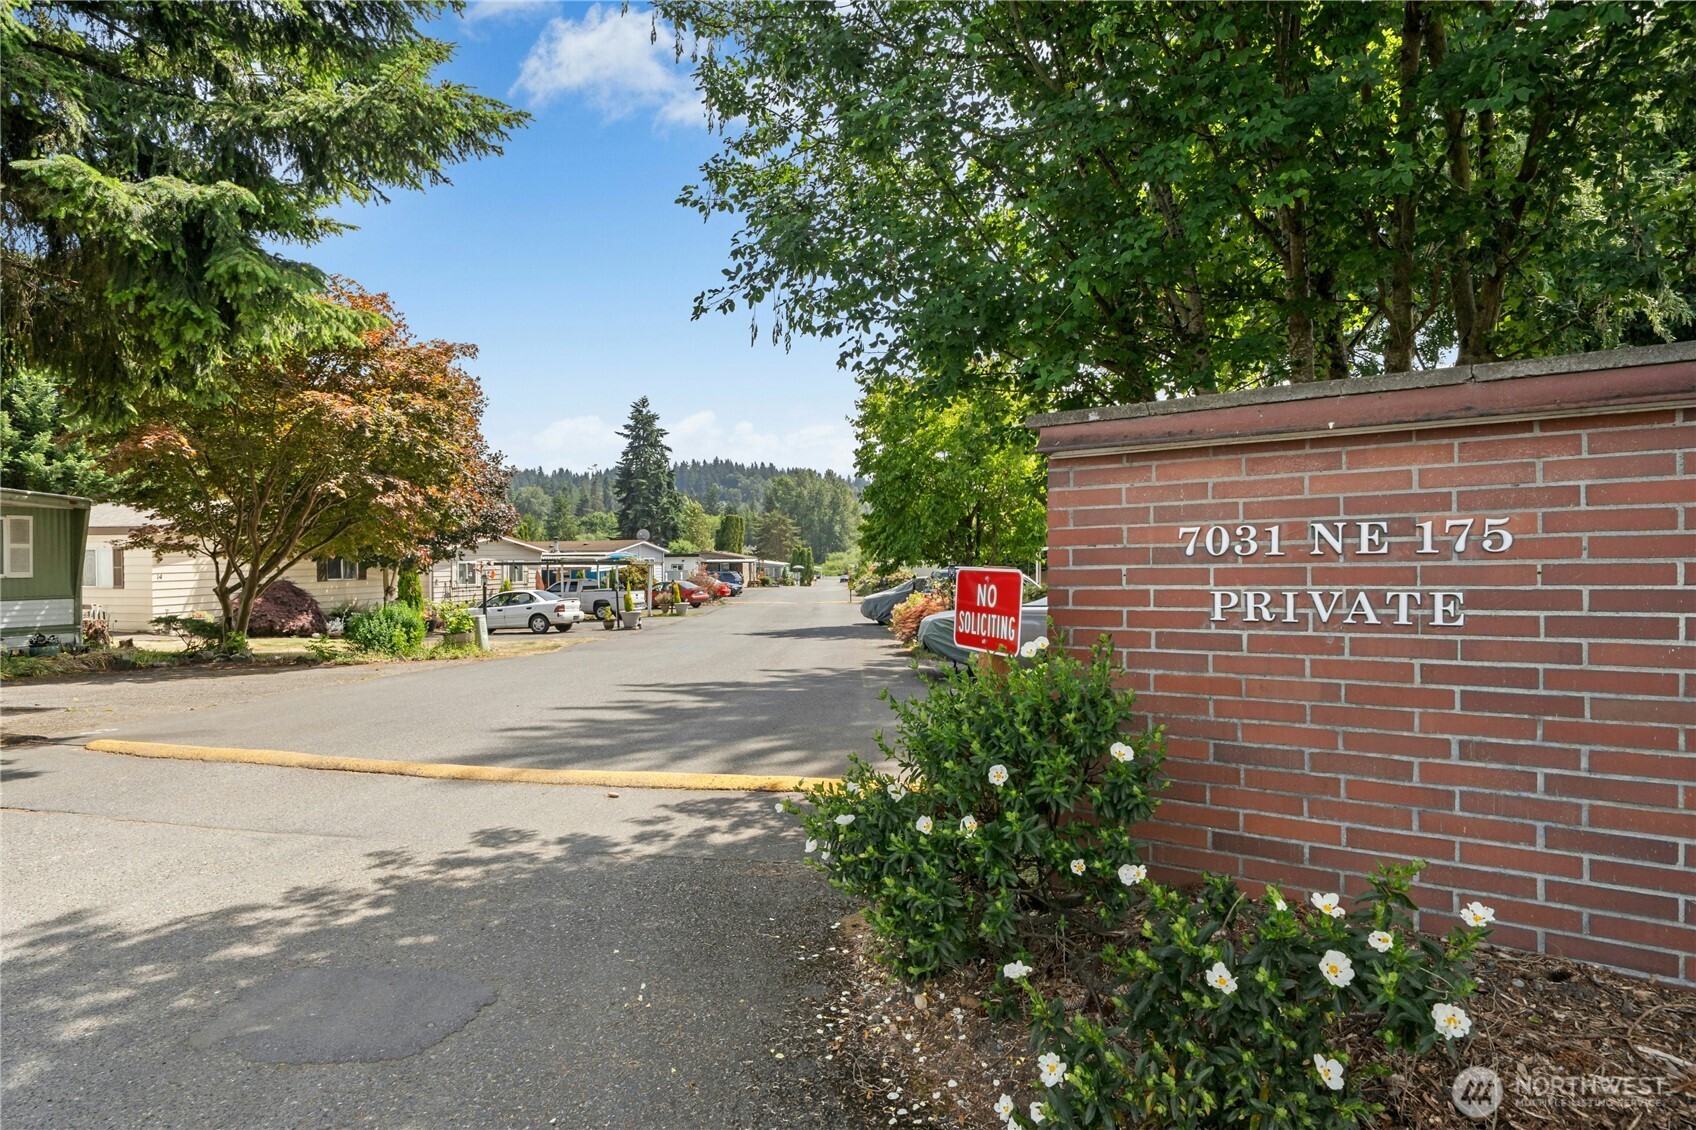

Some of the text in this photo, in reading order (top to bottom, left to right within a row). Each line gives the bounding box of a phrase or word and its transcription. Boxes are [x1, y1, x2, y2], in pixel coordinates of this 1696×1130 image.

[1178, 517, 1514, 557] 7031 NE 175
[976, 583, 998, 608] NO
[1209, 591, 1466, 627] PRIVATE
[958, 610, 1016, 641] SOLICITING
